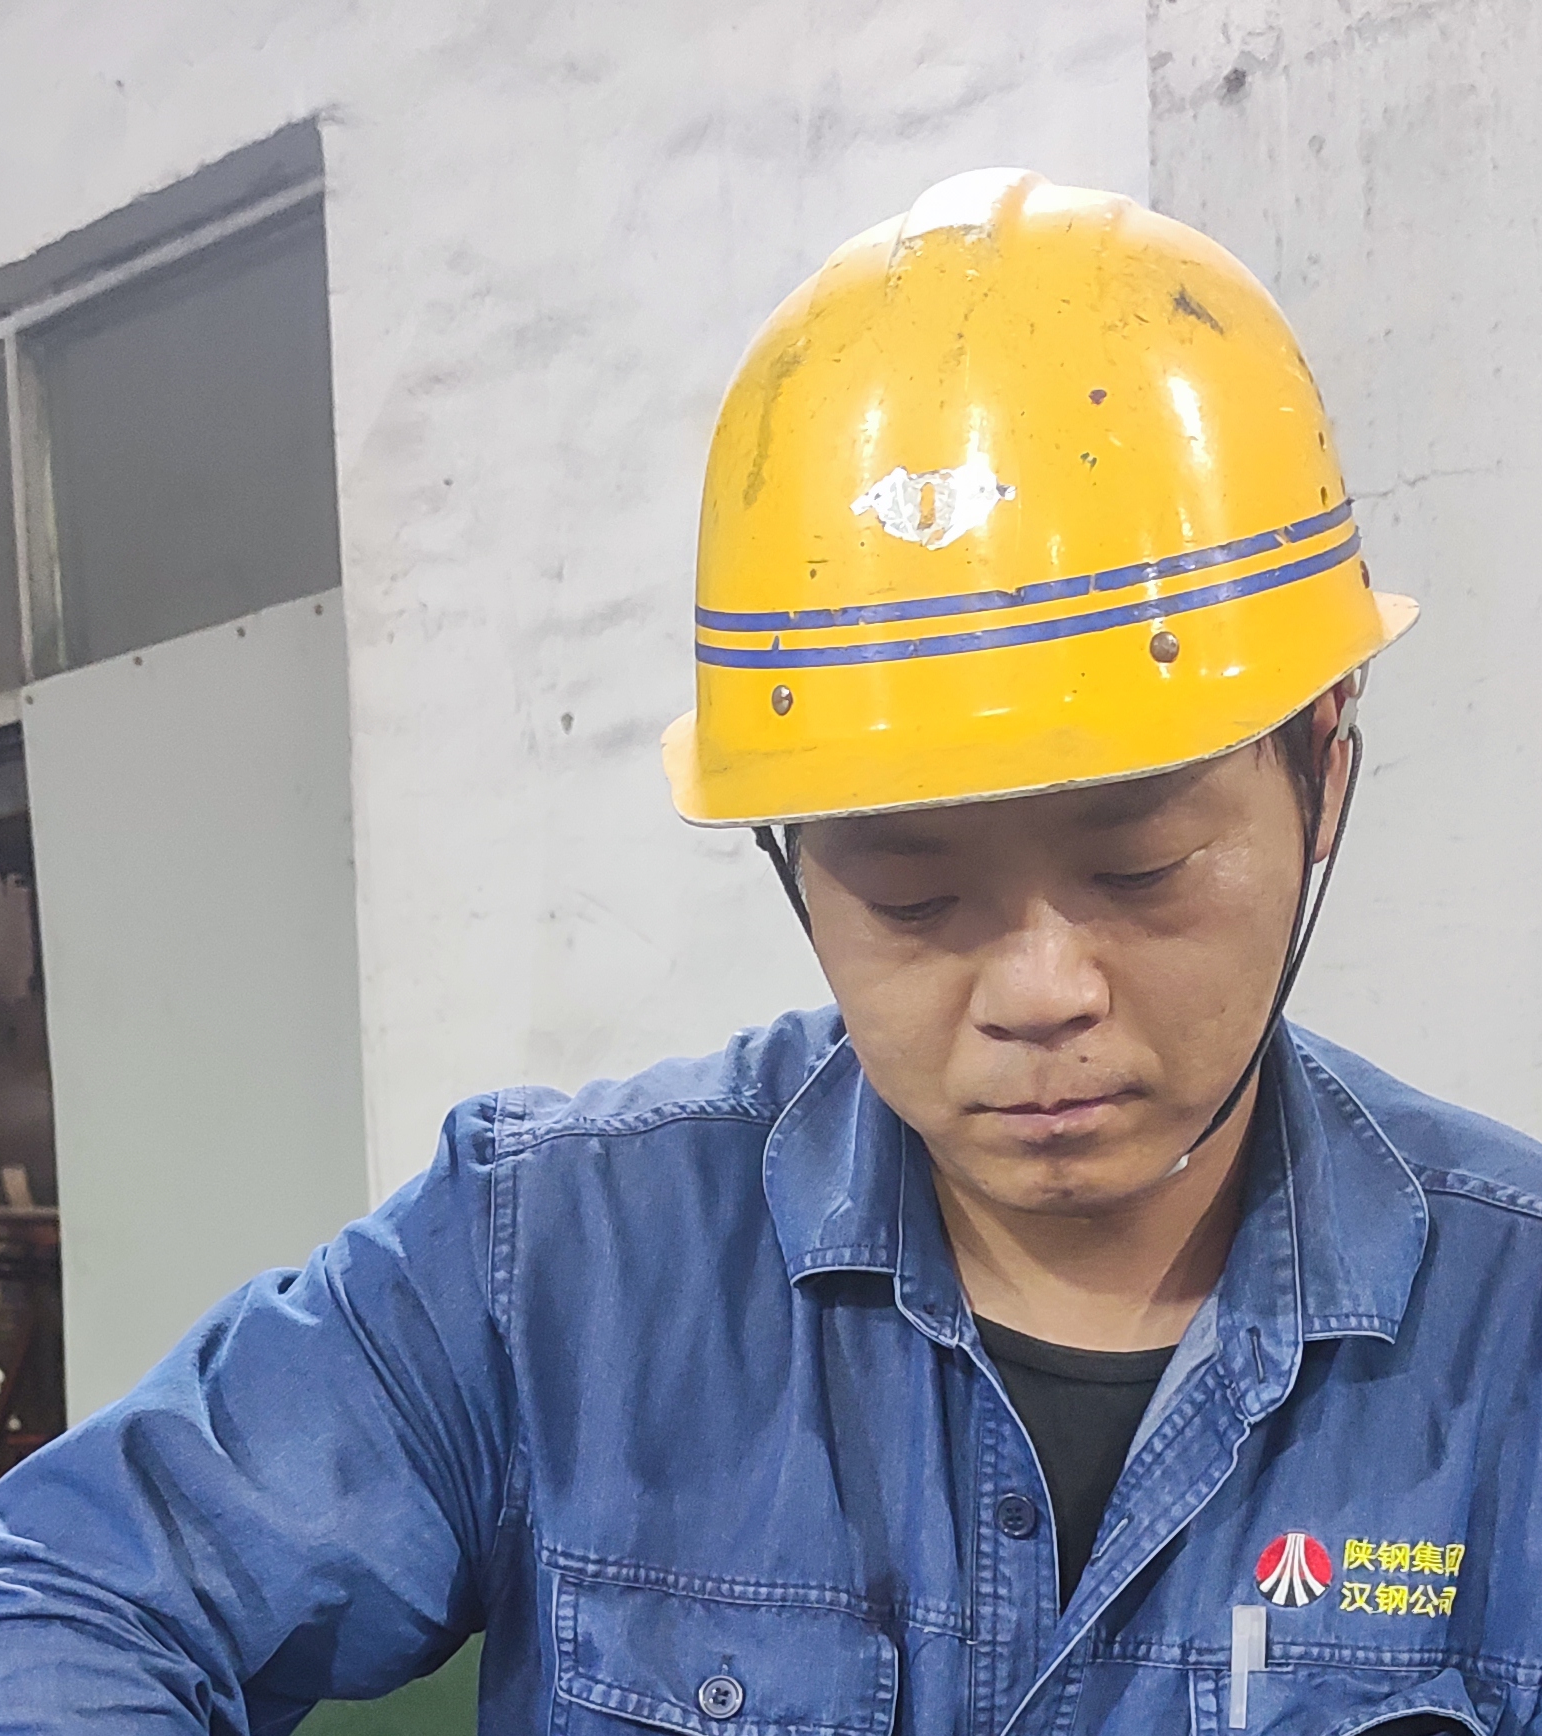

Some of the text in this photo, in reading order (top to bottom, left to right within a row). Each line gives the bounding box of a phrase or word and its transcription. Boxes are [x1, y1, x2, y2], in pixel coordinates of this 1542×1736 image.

[1342, 1537, 1465, 1577] 陕钢集团
[1339, 1580, 1457, 1618] 汉钢公司
